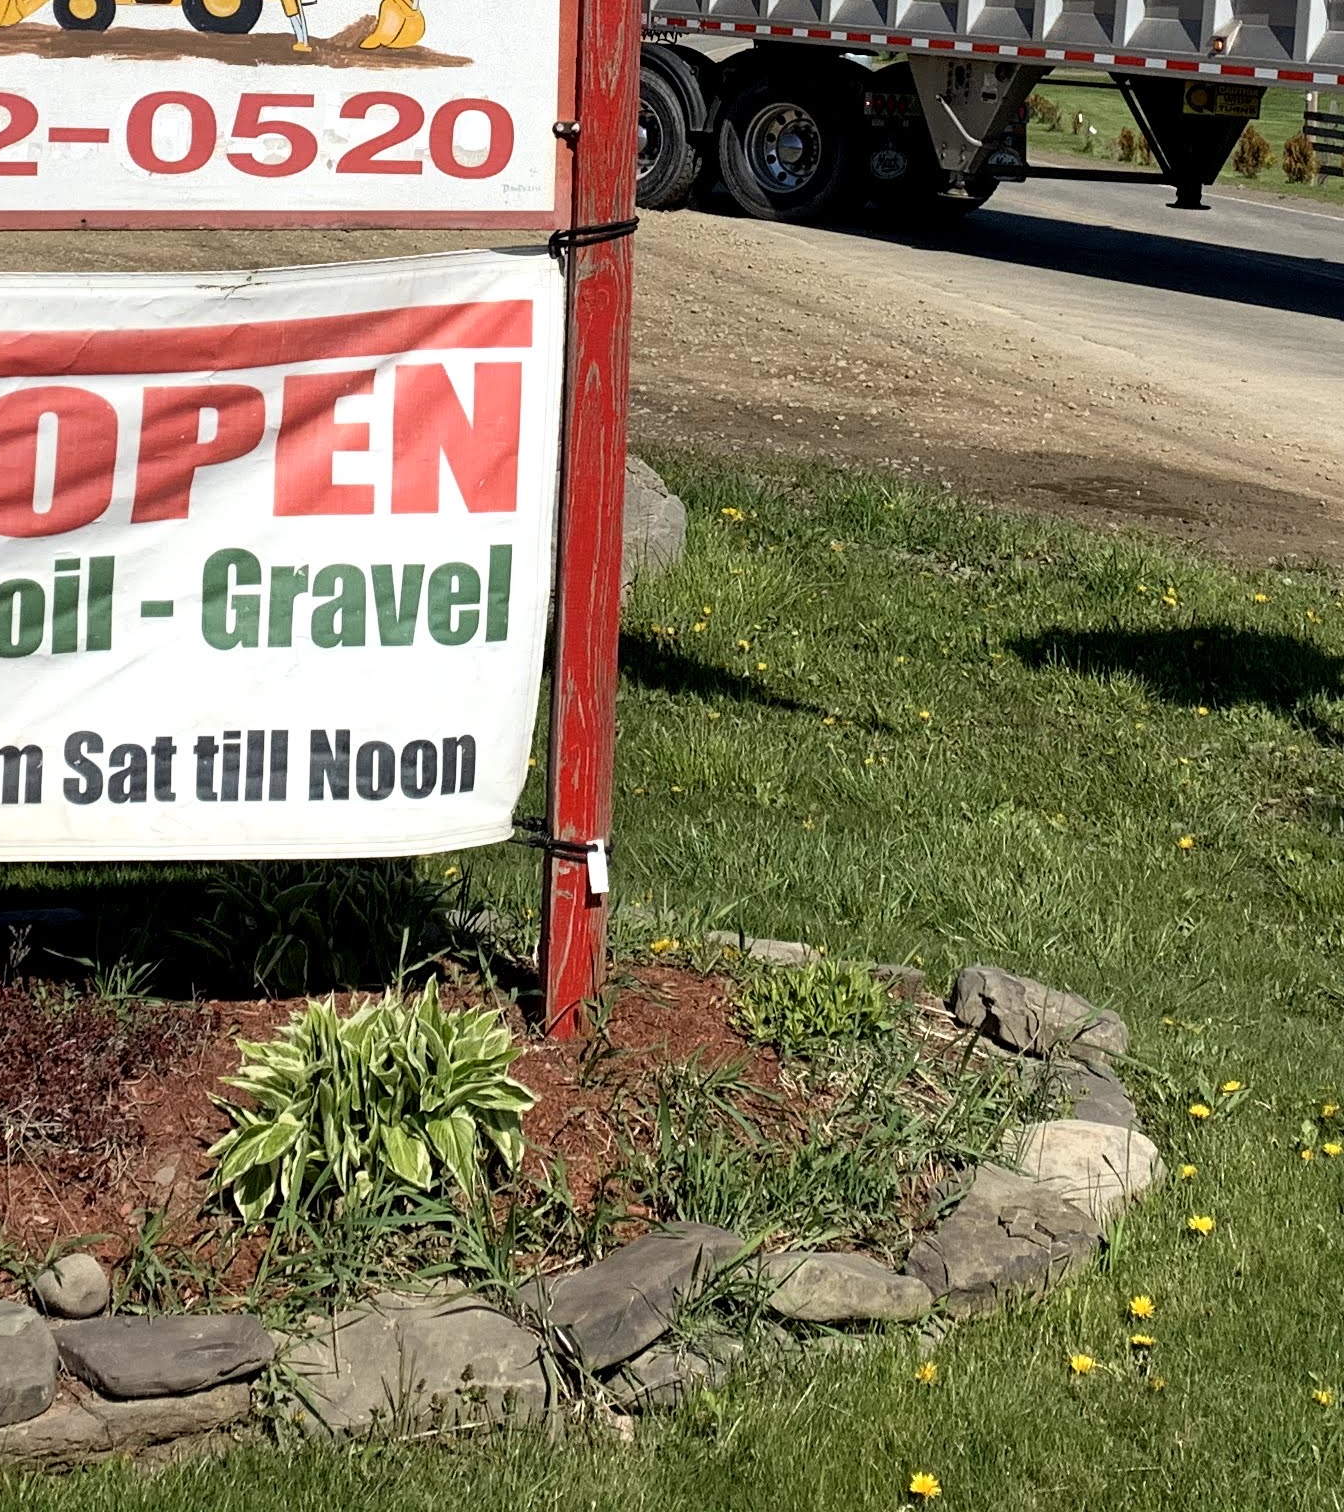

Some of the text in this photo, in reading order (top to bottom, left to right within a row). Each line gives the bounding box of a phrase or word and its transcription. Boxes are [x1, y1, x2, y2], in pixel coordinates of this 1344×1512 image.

[199, 543, 514, 651] Gravel
[61, 729, 181, 805] Sat
[194, 729, 289, 805] till
[308, 727, 477, 803] Noon
